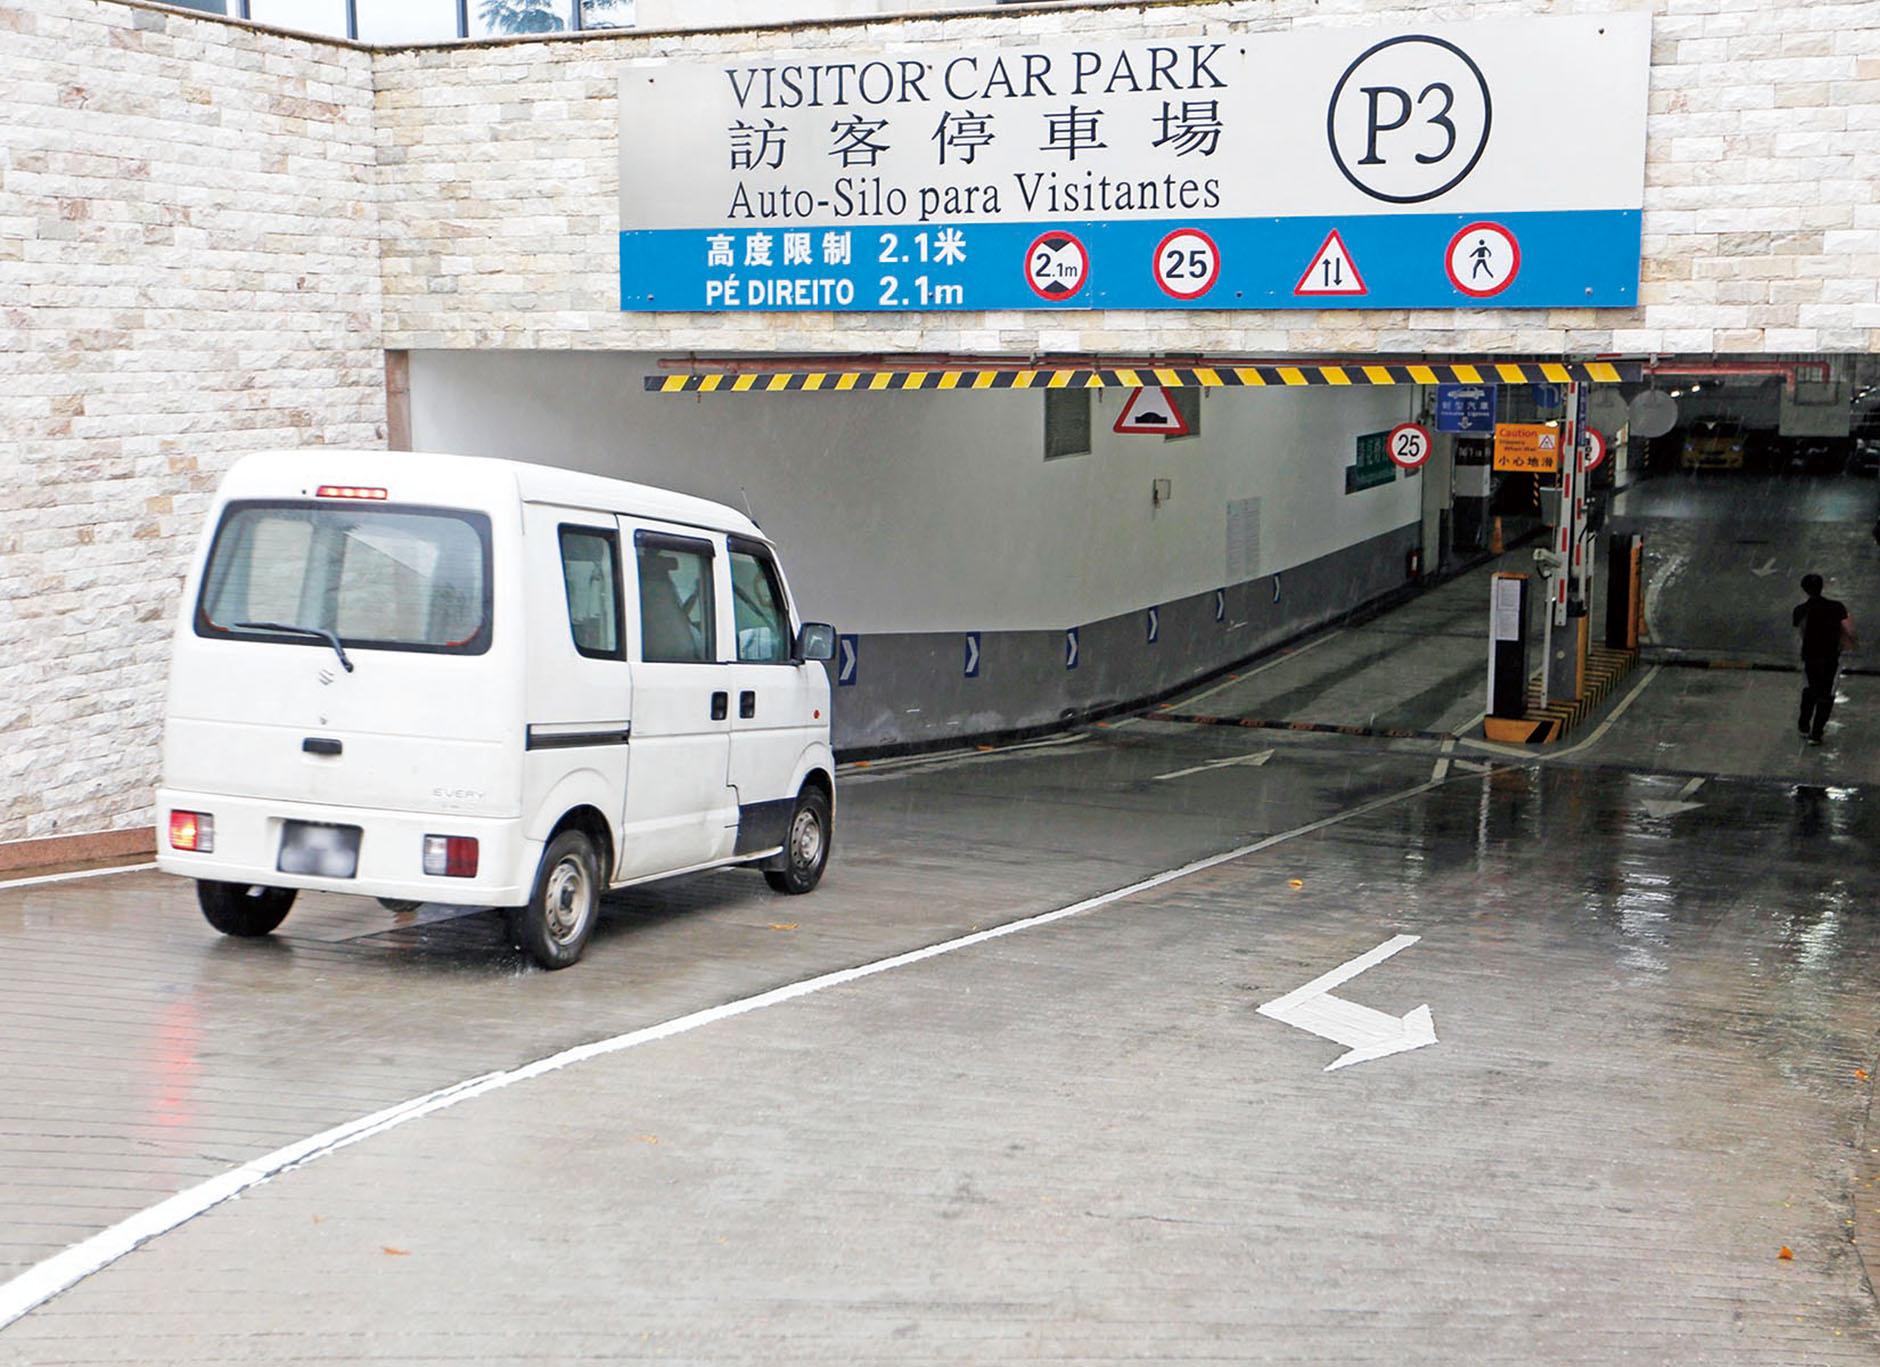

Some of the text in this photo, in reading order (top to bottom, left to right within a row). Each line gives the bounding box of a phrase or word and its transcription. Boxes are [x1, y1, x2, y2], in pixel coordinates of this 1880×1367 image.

[725, 43, 1229, 109] VISITOR CAR PARK
[728, 99, 1224, 171] 訪客停車場
[1357, 82, 1456, 165] P3
[727, 170, 1220, 222] Auto-Silo para Visitantes
[706, 228, 967, 268] 高度限制 2.1米
[1035, 252, 1079, 279] 2.1m
[1165, 250, 1208, 279] 25
[706, 274, 964, 306] PÉ DIREITO 2.1m
[1397, 434, 1421, 457] 25
[1499, 428, 1538, 438] Caution
